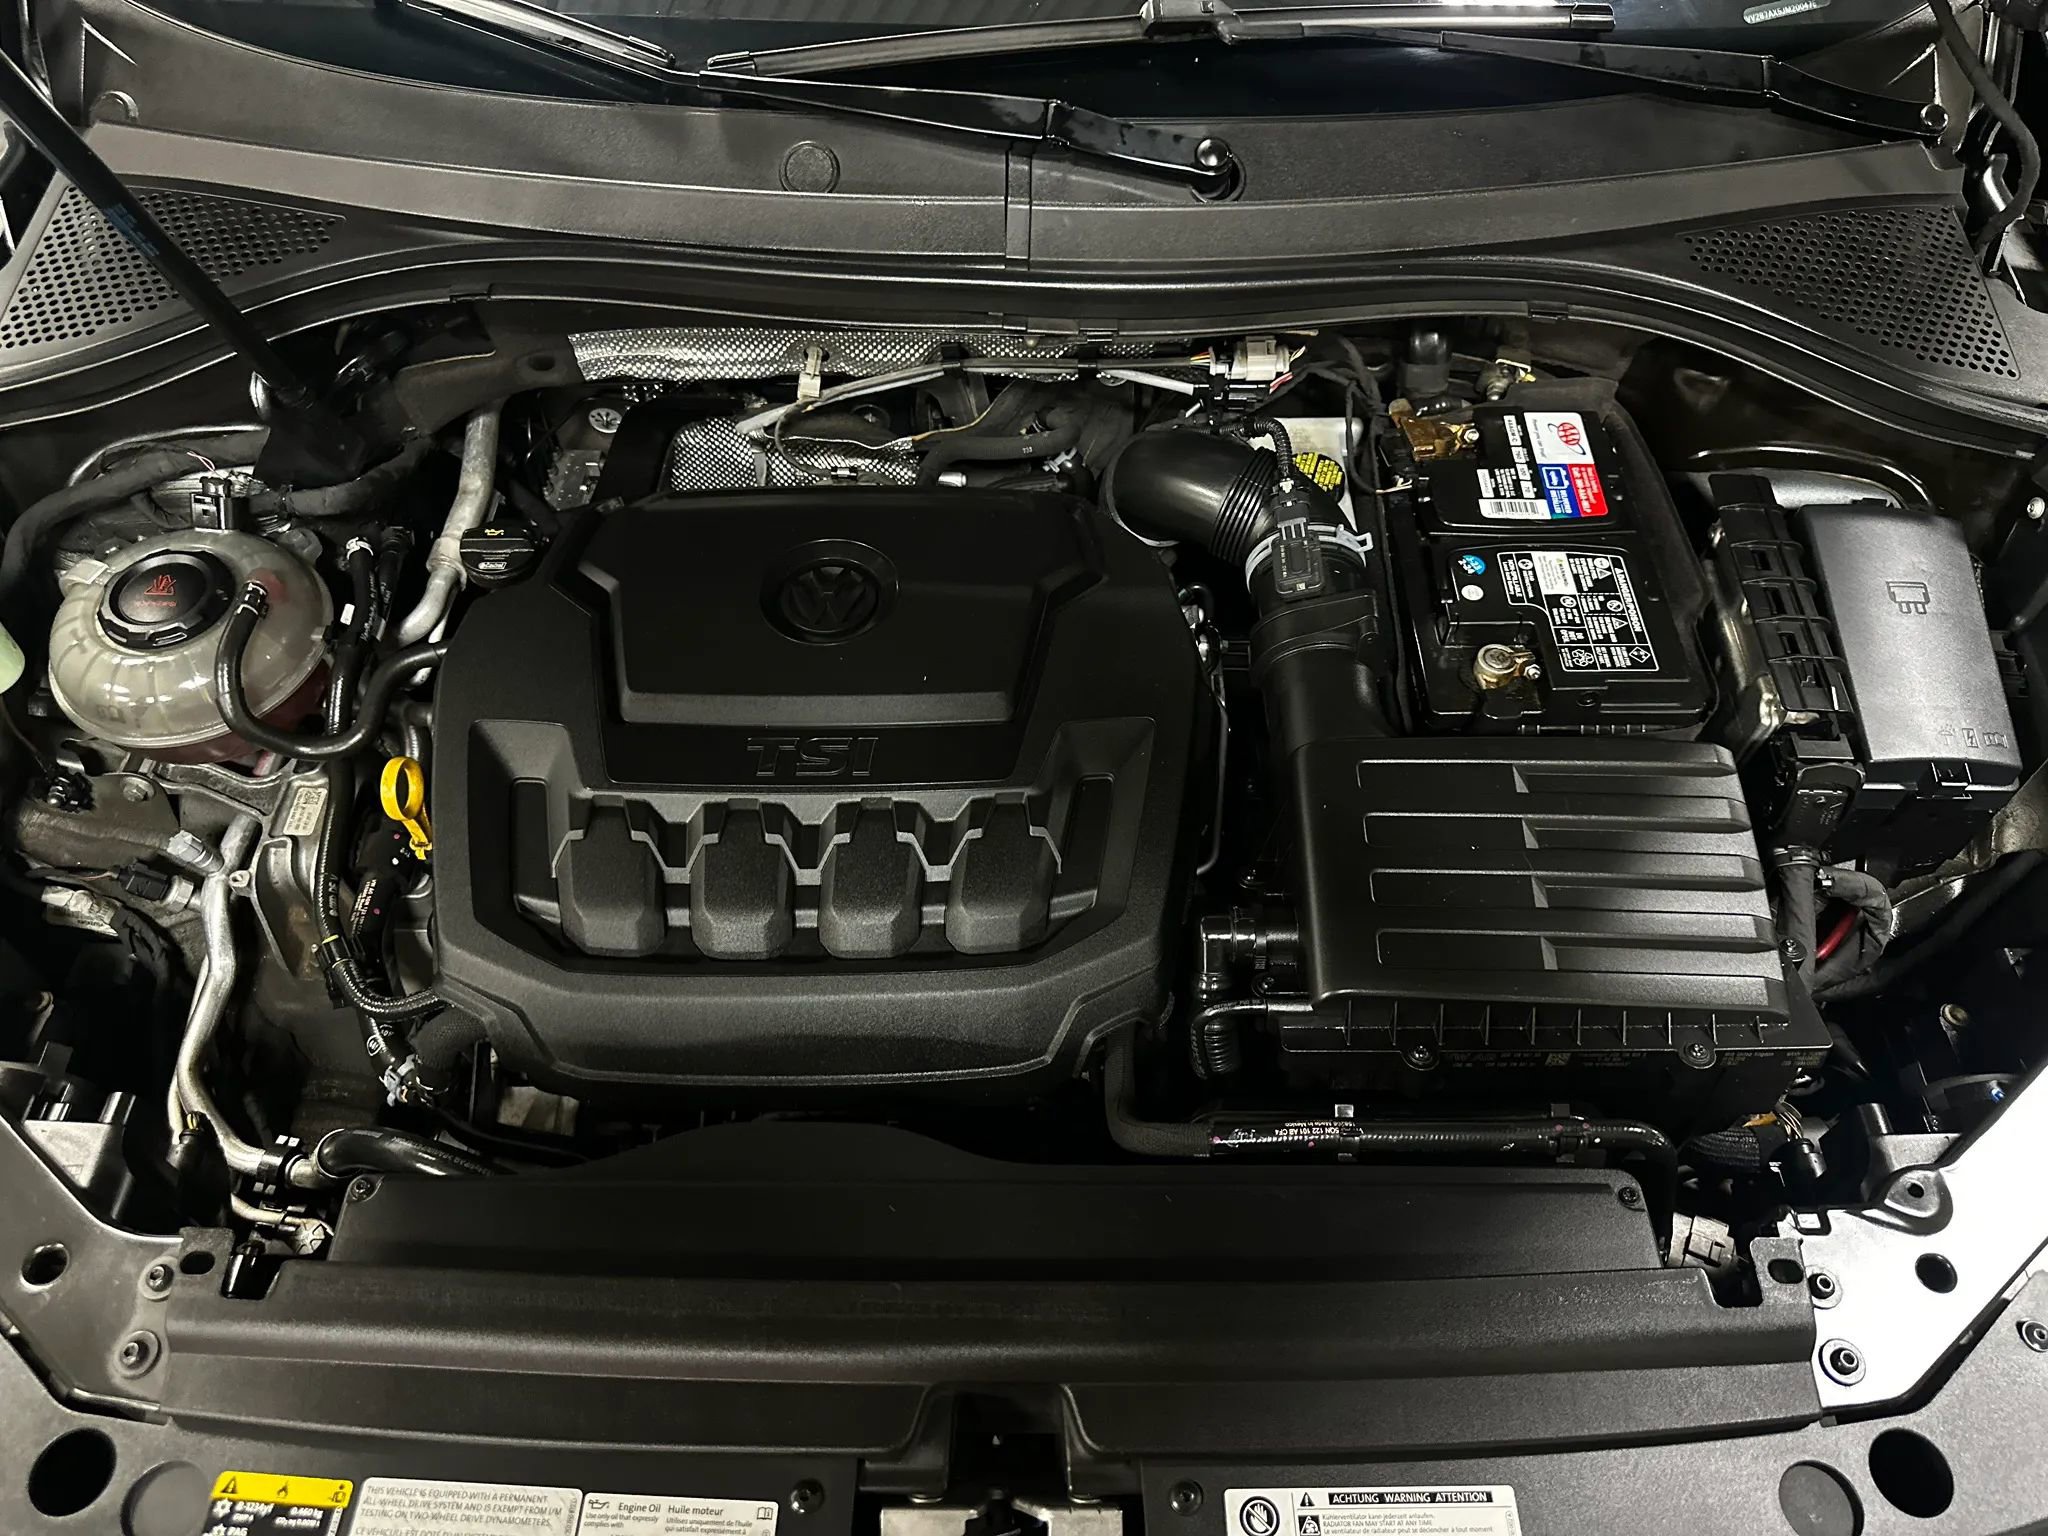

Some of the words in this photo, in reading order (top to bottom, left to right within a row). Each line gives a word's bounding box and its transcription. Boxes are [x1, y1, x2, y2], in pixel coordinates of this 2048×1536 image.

[1555, 422, 1582, 445] AAA
[1506, 559, 1522, 597] NON-SPILLABLE
[1616, 574, 1642, 631] DANGER/POISON
[746, 737, 879, 777] TSI
[368, 1486, 384, 1494] THIS
[386, 1487, 418, 1496] VEHICLE
[420, 1488, 427, 1496] IS
[428, 1488, 468, 1499] EQUIPPED
[469, 1491, 490, 1500] WITH
[500, 1492, 548, 1503] PERMANENT
[1332, 1493, 1380, 1504] ACHTUNG
[1383, 1492, 1431, 1503] WARNING
[1436, 1492, 1488, 1502] ATTENTION
[363, 1496, 407, 1508] ALL-WHEEL
[408, 1500, 432, 1509] DRIVE
[434, 1500, 462, 1510] SYSTEM
[464, 1502, 482, 1511] AND
[484, 1503, 491, 1511] IS
[493, 1504, 523, 1514] EXEMPT
[524, 1505, 548, 1514] FROM
[618, 1502, 648, 1514] Engine
[648, 1504, 662, 1512] Oil
[668, 1504, 690, 1514] Huile
[692, 1506, 724, 1516] moteur
[361, 1508, 394, 1518] TESTING
[394, 1510, 407, 1519] ON
[410, 1511, 458, 1522] TWO-WHEEL
[460, 1514, 484, 1523] DRIVE
